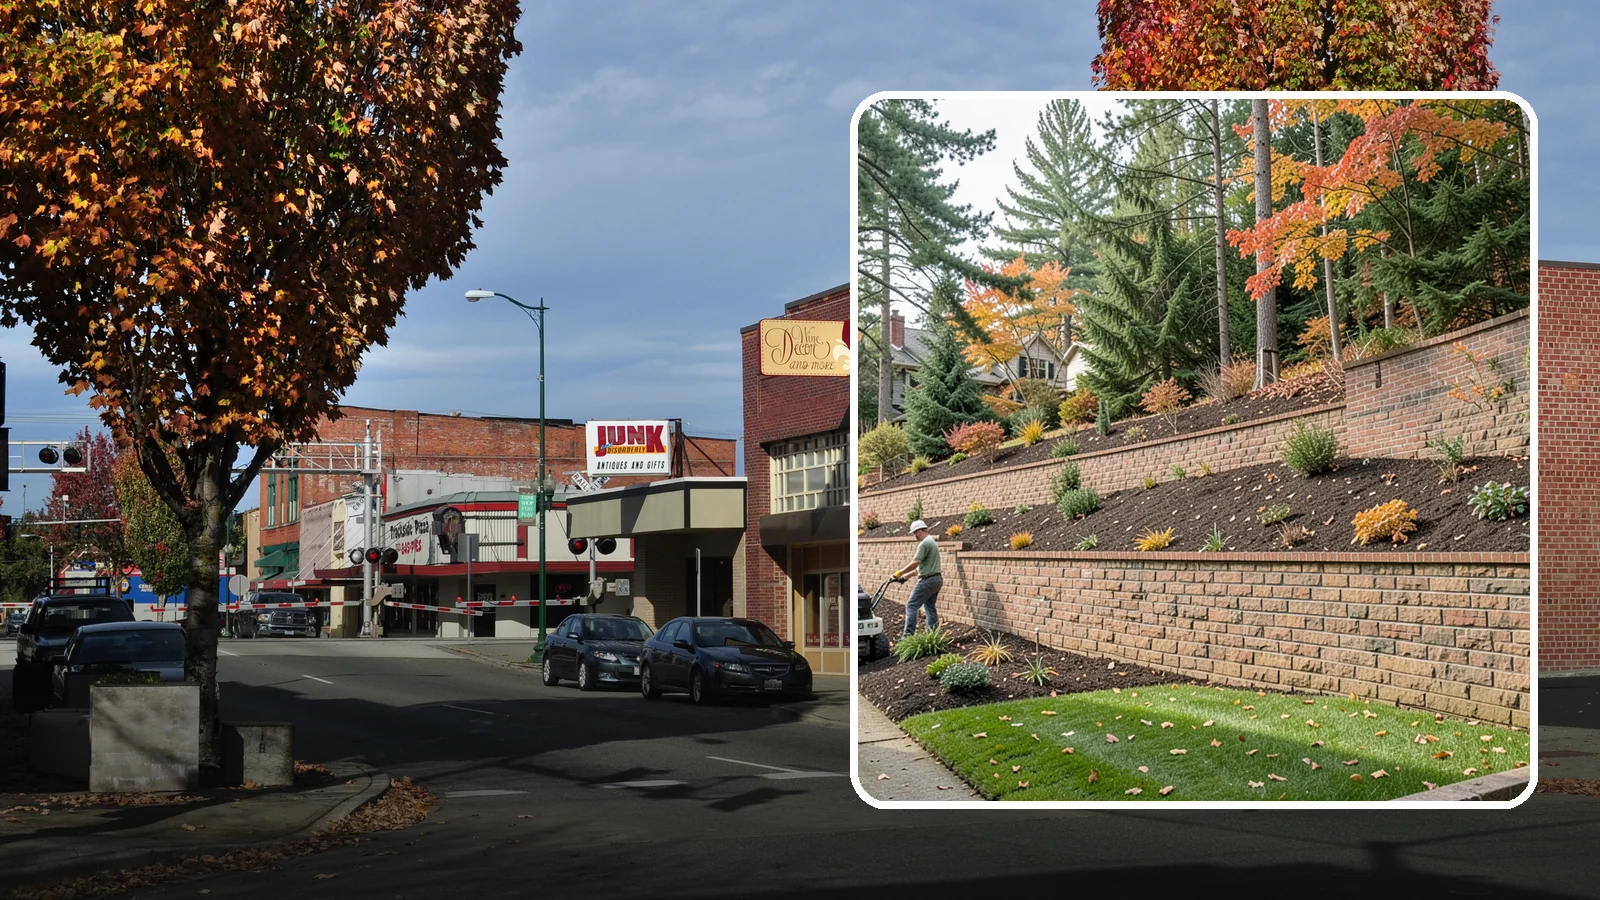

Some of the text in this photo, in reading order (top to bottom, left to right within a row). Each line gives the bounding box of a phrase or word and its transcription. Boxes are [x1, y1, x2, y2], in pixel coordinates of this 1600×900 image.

[595, 425, 665, 457] JUNK
[607, 446, 645, 454] DISORDERLY
[596, 460, 665, 470] ANTIQUES AND GIFTS
[414, 519, 429, 535] Pizza
